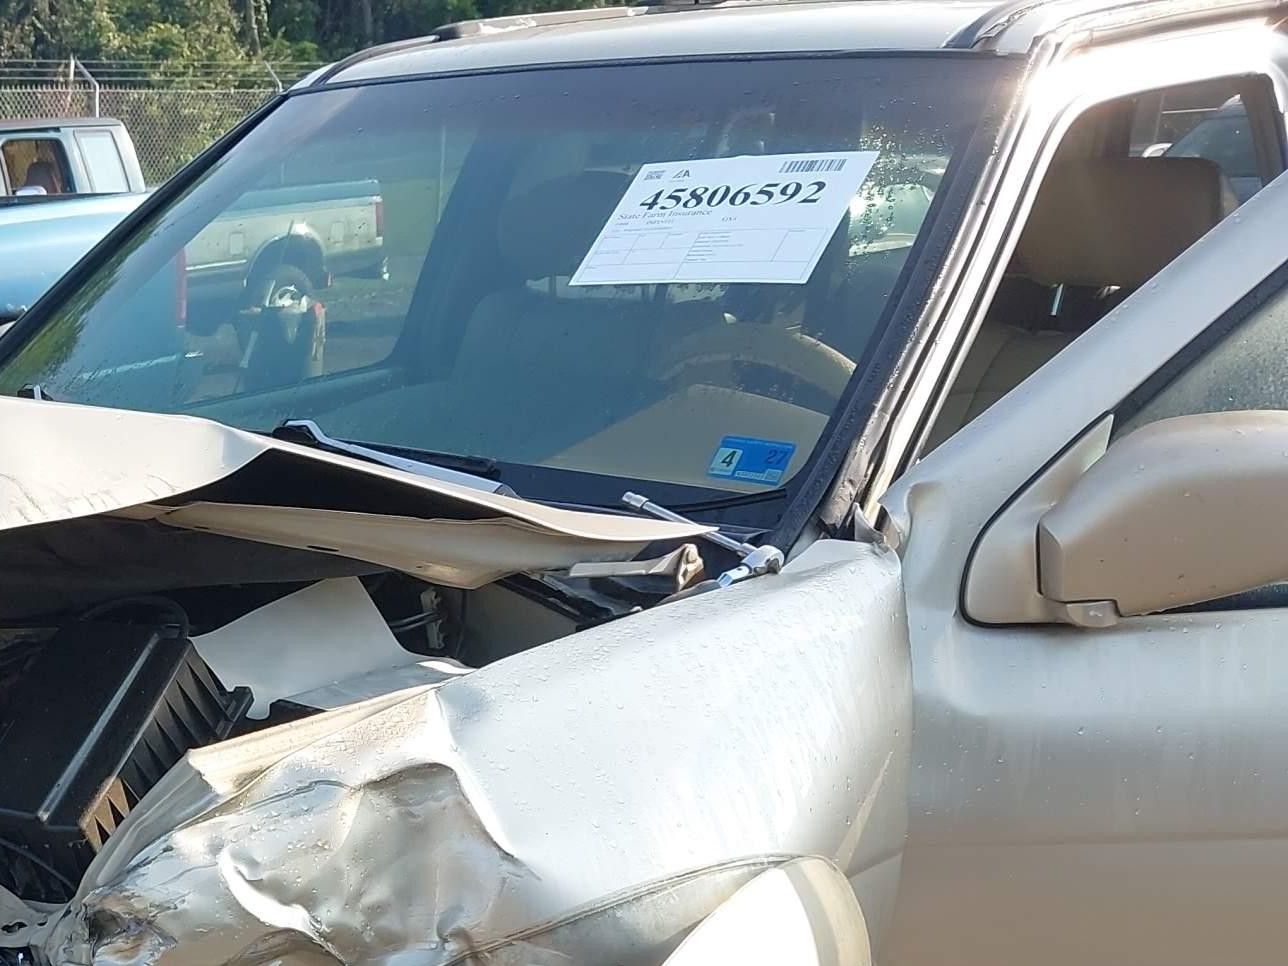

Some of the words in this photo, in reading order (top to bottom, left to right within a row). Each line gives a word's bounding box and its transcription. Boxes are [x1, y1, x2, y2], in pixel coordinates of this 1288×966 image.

[639, 181, 827, 211] 45806592
[720, 449, 738, 468] 4
[765, 448, 790, 466] 27
